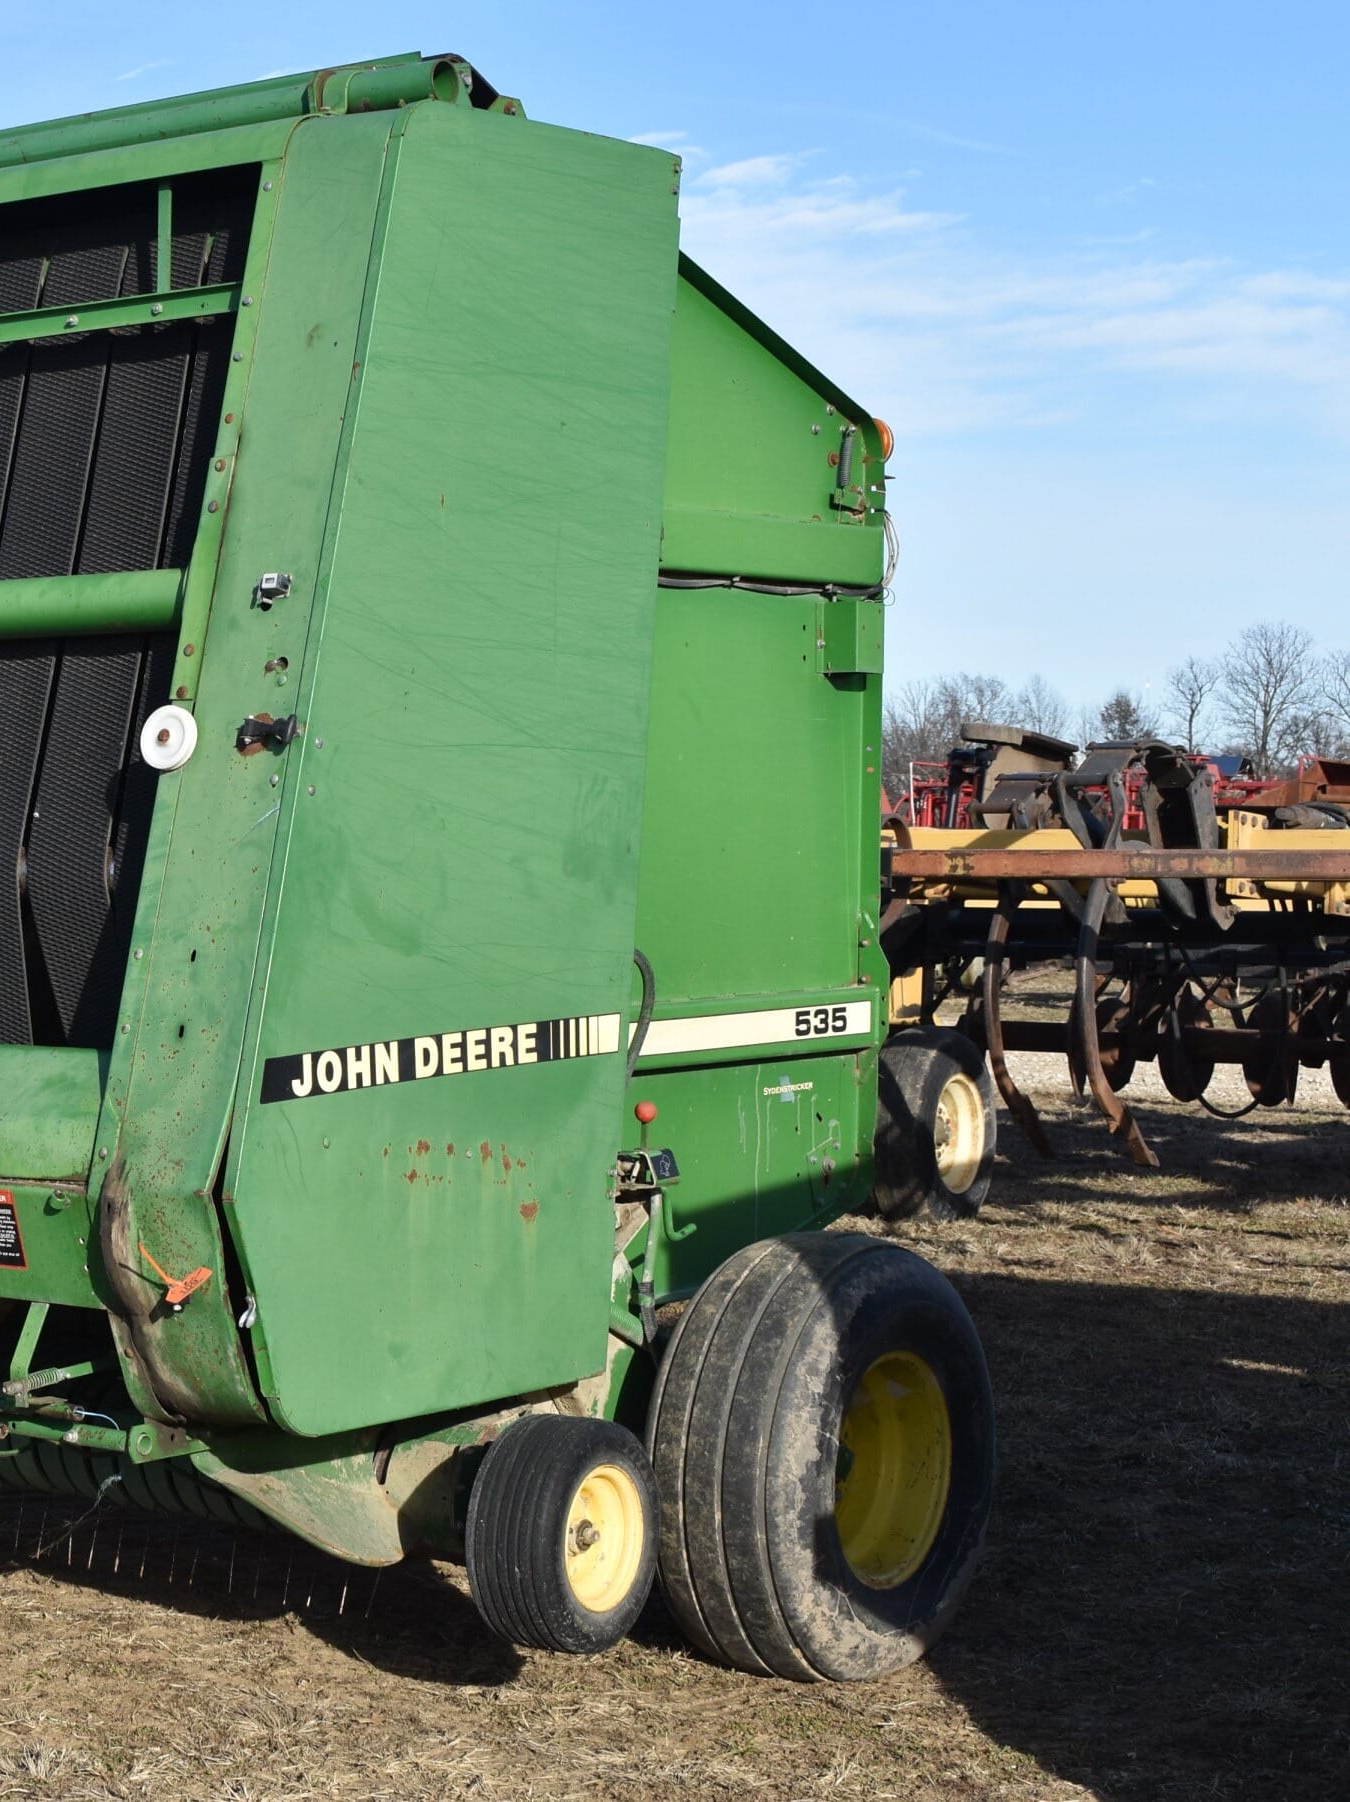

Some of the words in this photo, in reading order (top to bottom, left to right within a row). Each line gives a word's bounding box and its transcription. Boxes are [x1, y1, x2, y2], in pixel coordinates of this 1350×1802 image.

[795, 1007, 847, 1036] 535
[291, 1040, 399, 1097] JOHN
[414, 1022, 538, 1079] DEERE
